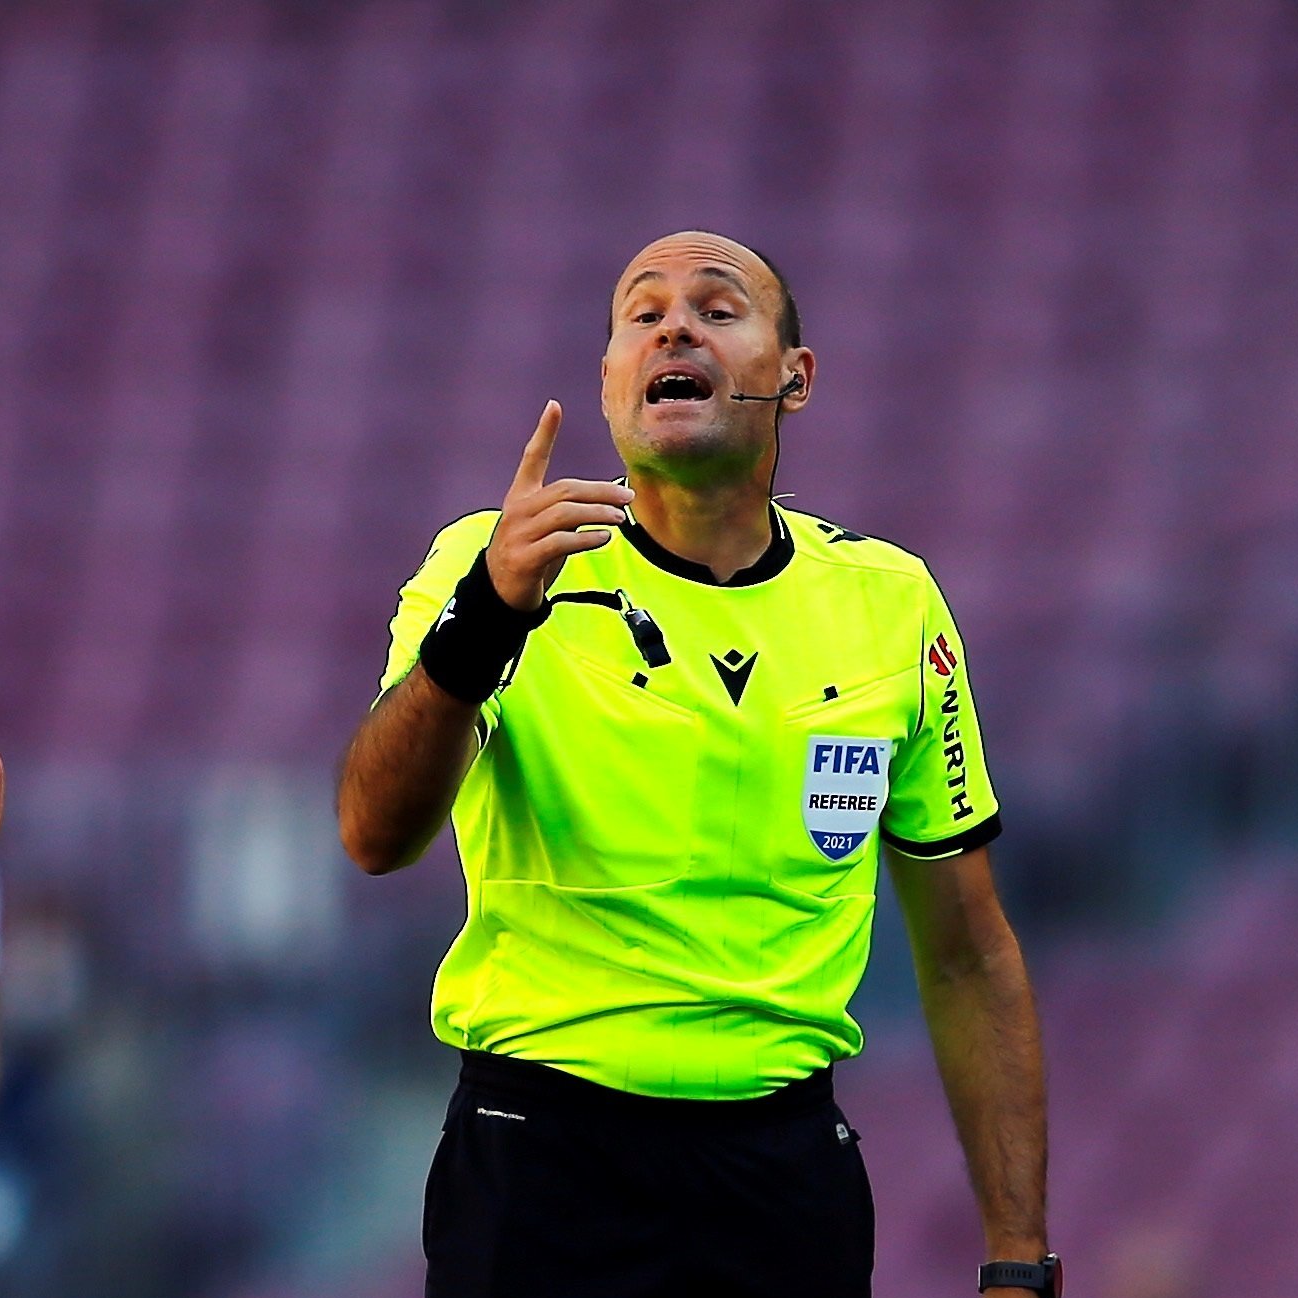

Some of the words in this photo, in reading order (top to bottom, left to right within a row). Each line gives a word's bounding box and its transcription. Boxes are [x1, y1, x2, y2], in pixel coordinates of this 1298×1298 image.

[813, 744, 880, 775] FIFA
[809, 793, 878, 811] REFEREE
[822, 835, 853, 850] 2021
